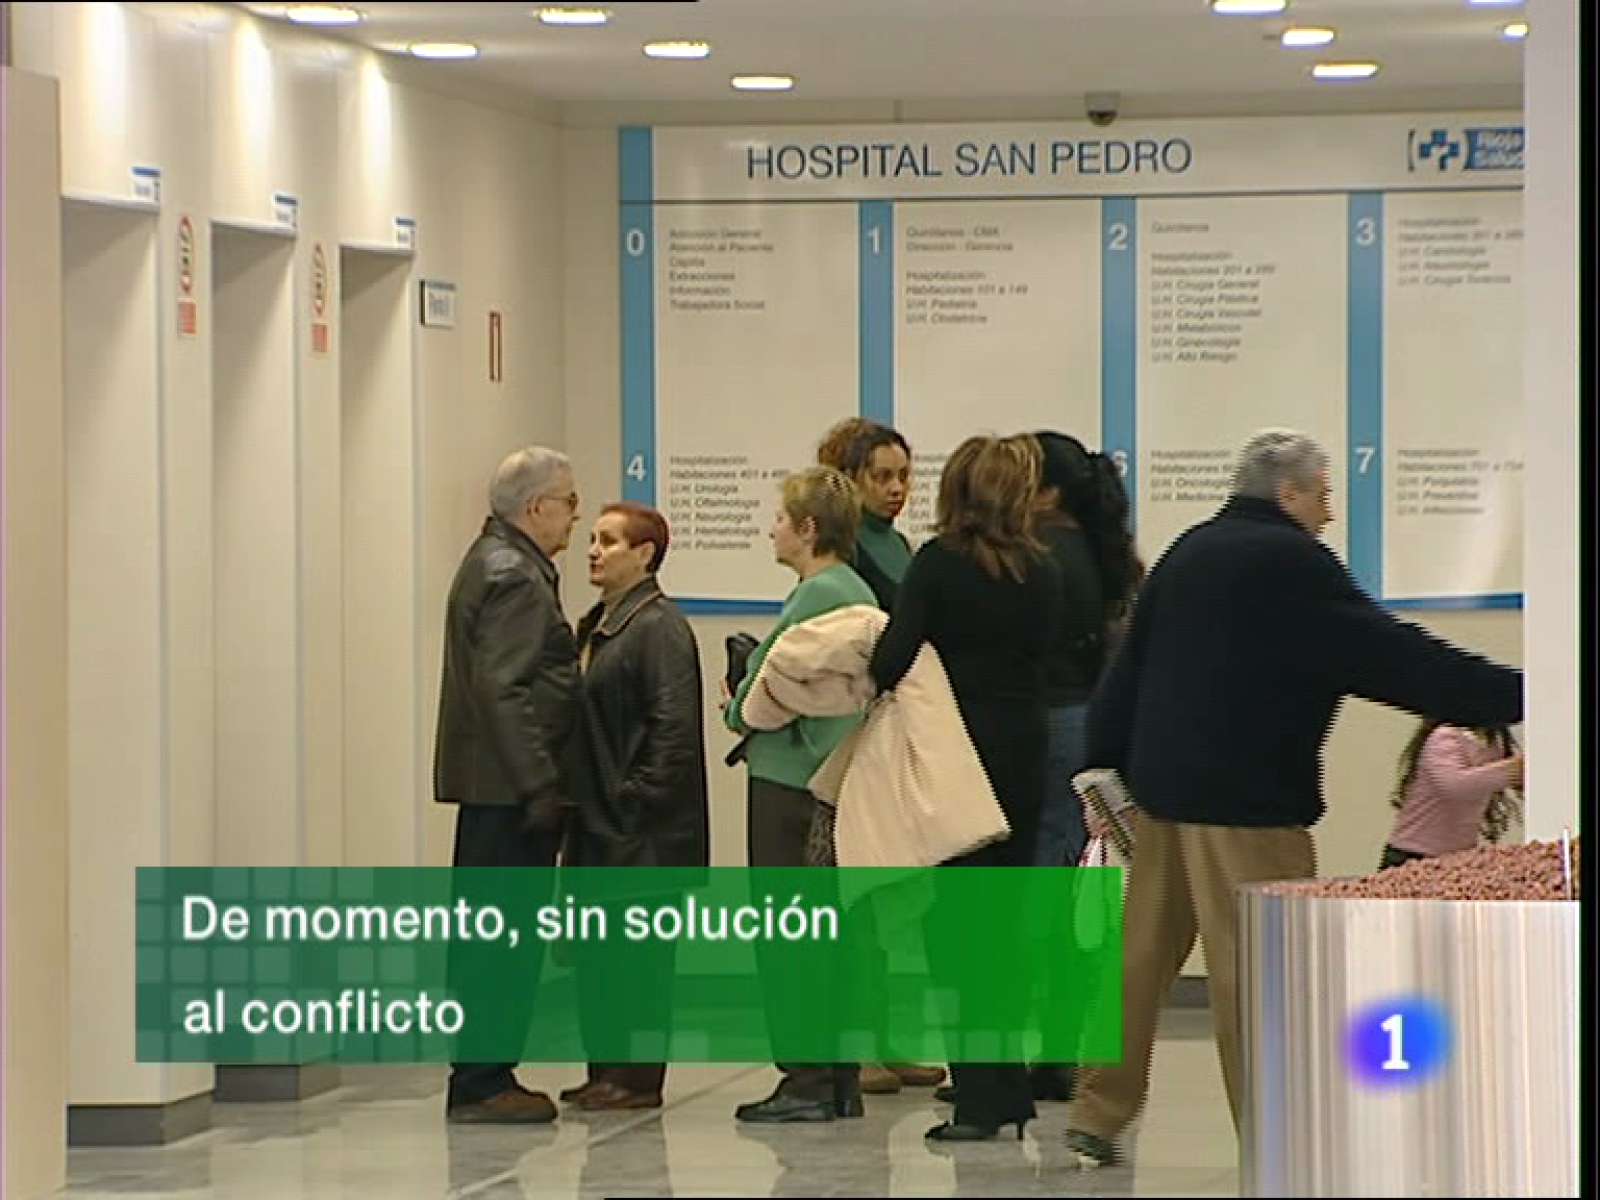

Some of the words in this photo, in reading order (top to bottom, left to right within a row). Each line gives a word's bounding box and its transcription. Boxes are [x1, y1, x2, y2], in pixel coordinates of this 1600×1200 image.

[747, 144, 942, 179] HOSPITAL
[955, 141, 1035, 176] SAN
[1051, 138, 1193, 174] PEDRO
[626, 228, 646, 257] 0
[866, 226, 880, 254] 1
[1108, 222, 1128, 251] 2
[1355, 218, 1376, 246] 3
[906, 270, 986, 282] Hospitalización
[626, 453, 647, 482] 4
[670, 456, 749, 466] Hospitalización
[1355, 446, 1376, 475] 7
